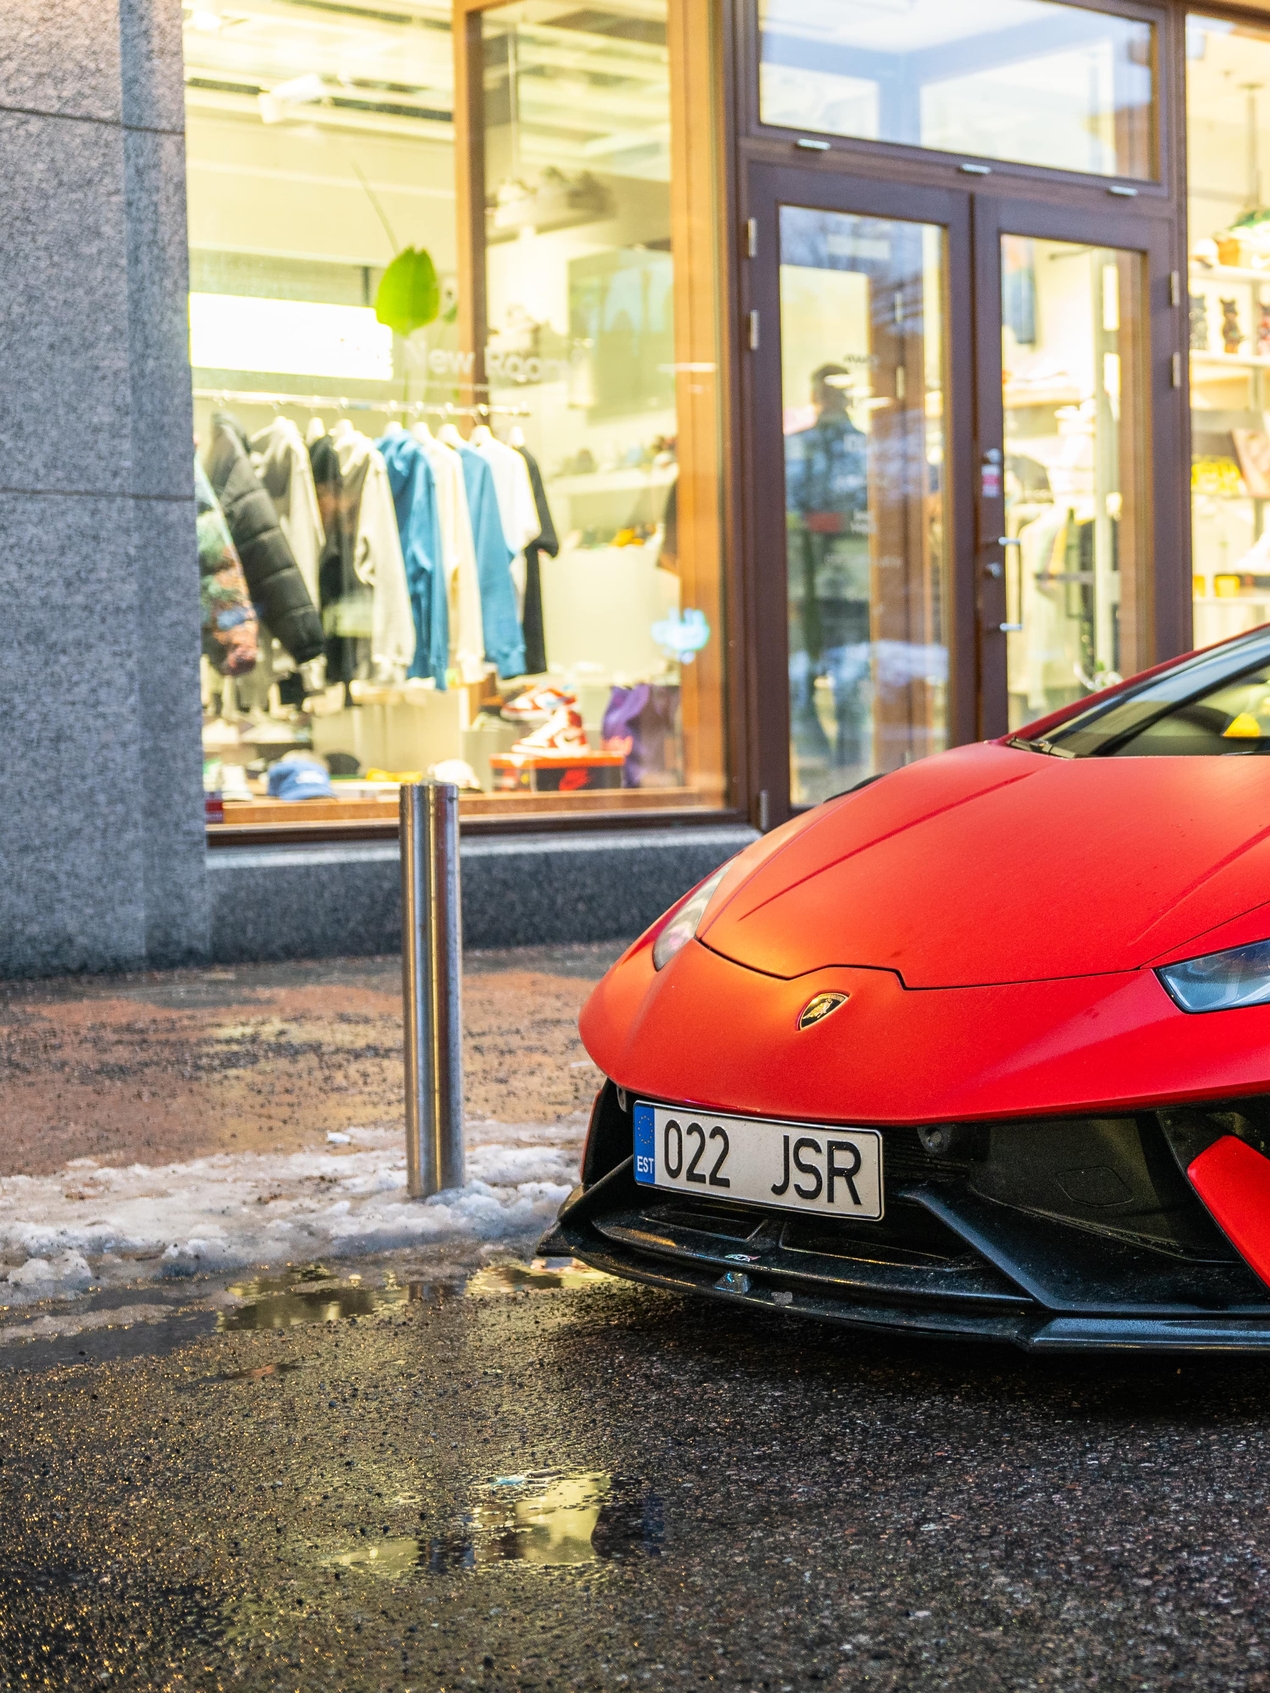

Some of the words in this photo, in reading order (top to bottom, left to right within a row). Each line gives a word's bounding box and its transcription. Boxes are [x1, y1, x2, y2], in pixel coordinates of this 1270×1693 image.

[403, 339, 475, 375] New
[637, 1155, 654, 1174] EST
[664, 1119, 731, 1189] 022
[770, 1134, 862, 1205] JSR
